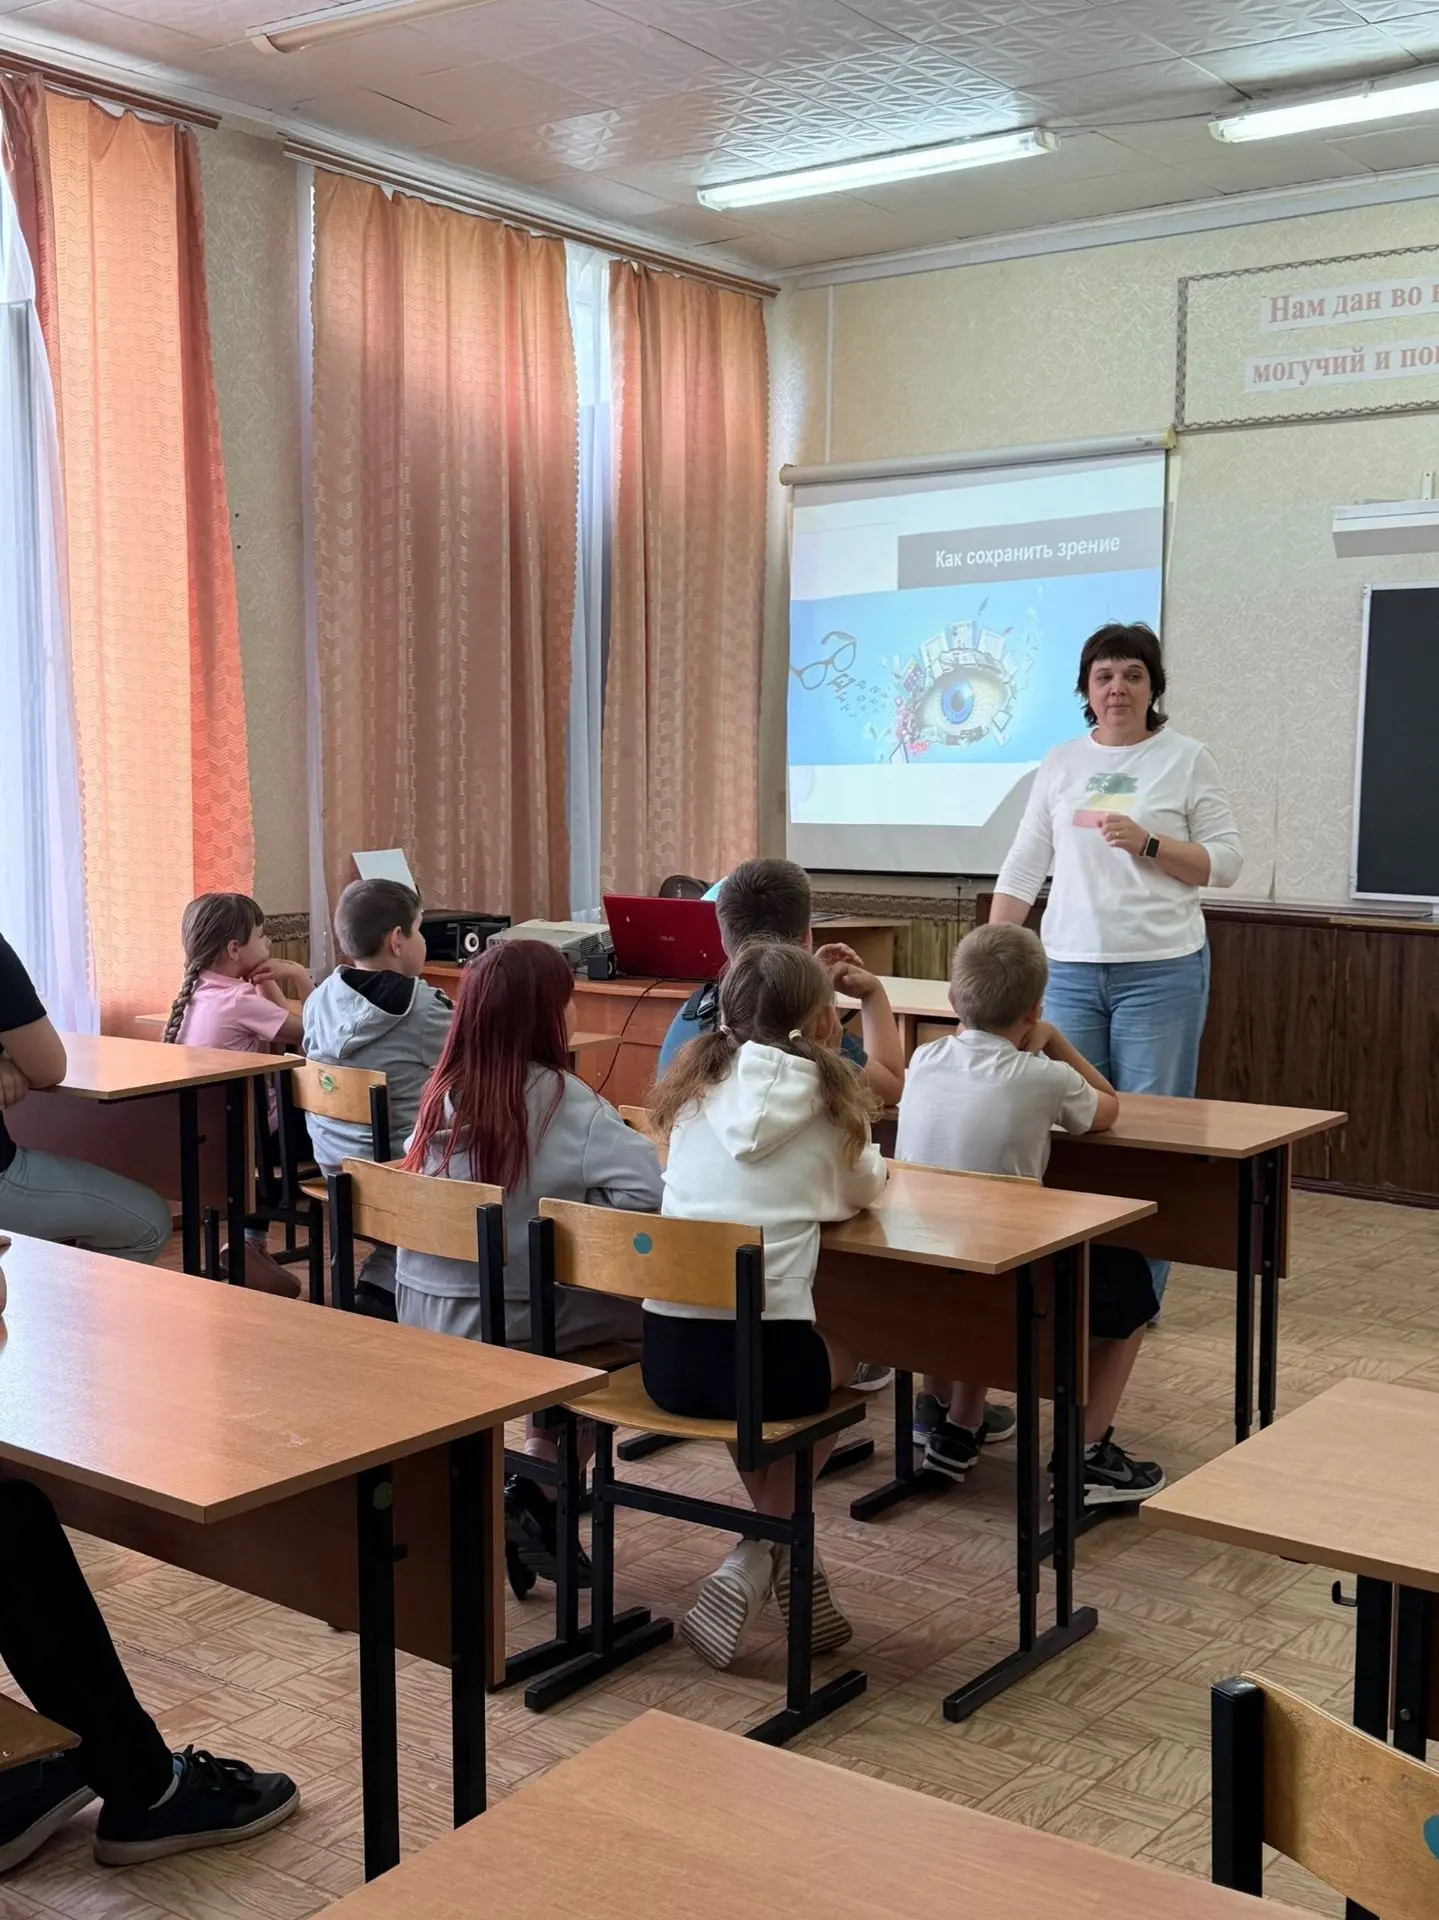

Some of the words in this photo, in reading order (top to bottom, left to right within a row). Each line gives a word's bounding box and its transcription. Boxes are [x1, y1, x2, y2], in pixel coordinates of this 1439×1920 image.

[1269, 295, 1325, 323] Нам
[1333, 291, 1382, 318] дан
[1391, 286, 1422, 308] во
[1252, 346, 1366, 386] могучий
[1374, 351, 1391, 370] и
[935, 550, 963, 568] Как
[966, 543, 1053, 567] сохранить
[1057, 536, 1120, 560] зрение
